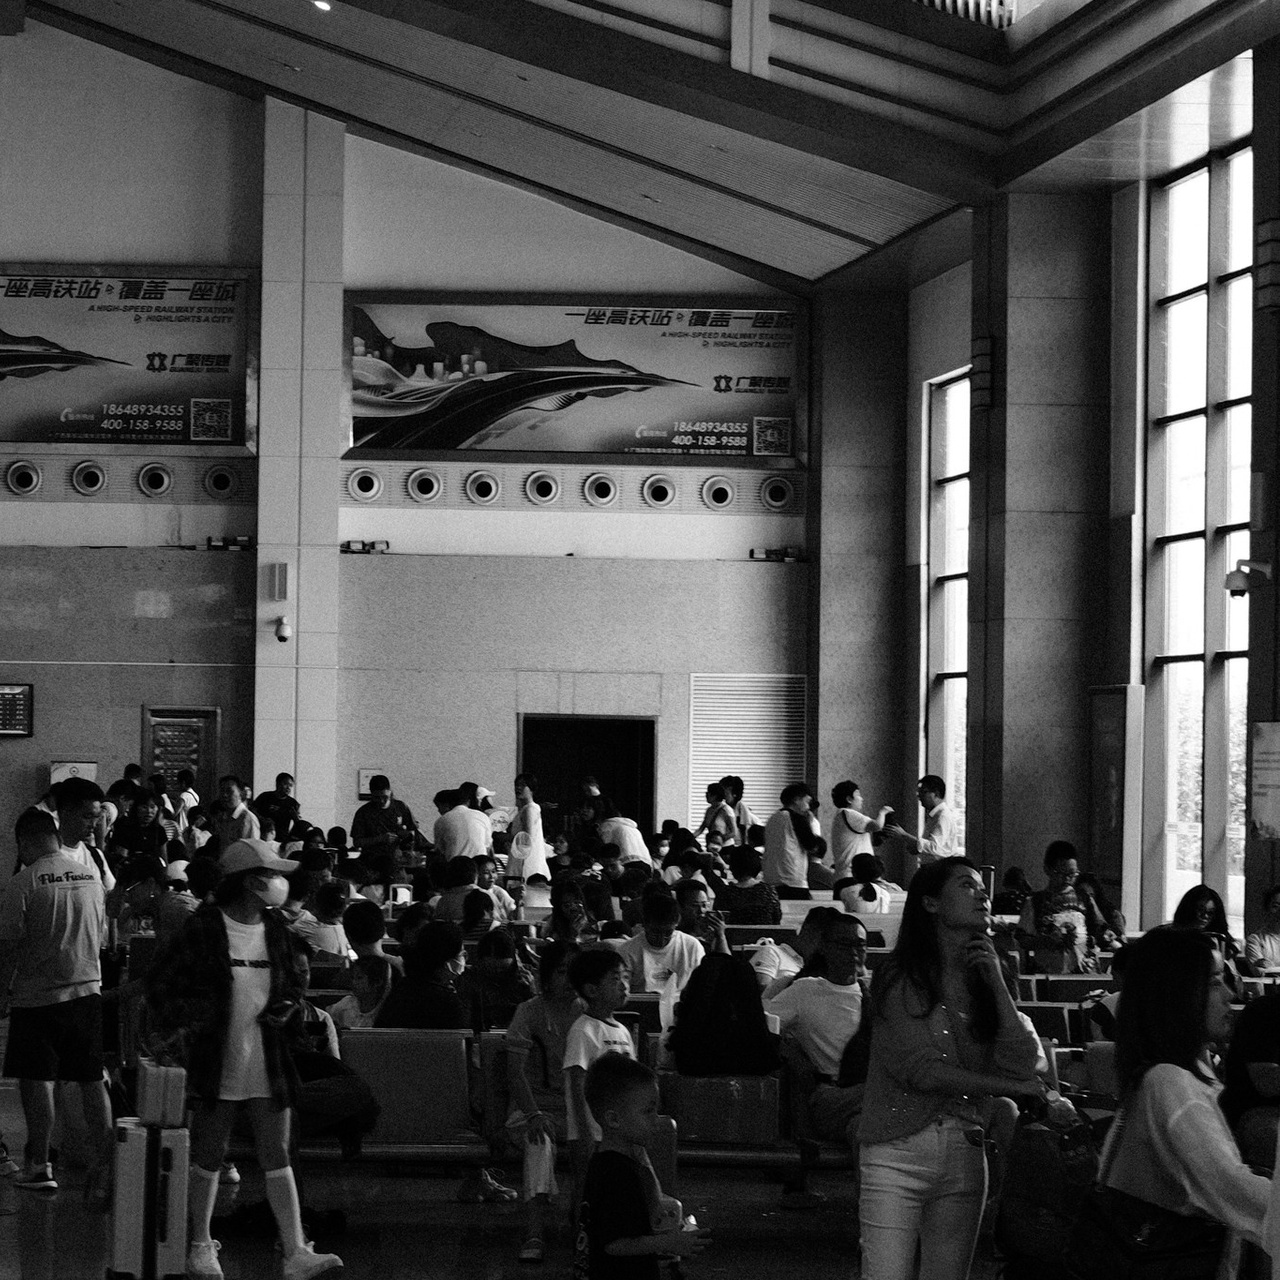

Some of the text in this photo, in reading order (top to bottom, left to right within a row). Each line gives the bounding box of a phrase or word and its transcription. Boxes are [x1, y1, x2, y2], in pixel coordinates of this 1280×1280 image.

[119, 280, 239, 302] 覆盖一座城
[96, 305, 153, 313] HIGH-SPEED
[195, 306, 235, 314] STATION
[565, 308, 673, 326] 一座高铁站
[102, 404, 184, 417] 18648934355
[100, 418, 184, 431] 400-158-9588
[673, 422, 749, 434] 18648934355
[671, 436, 748, 447] 400-158-9588
[63, 871, 95, 882] Fusion
